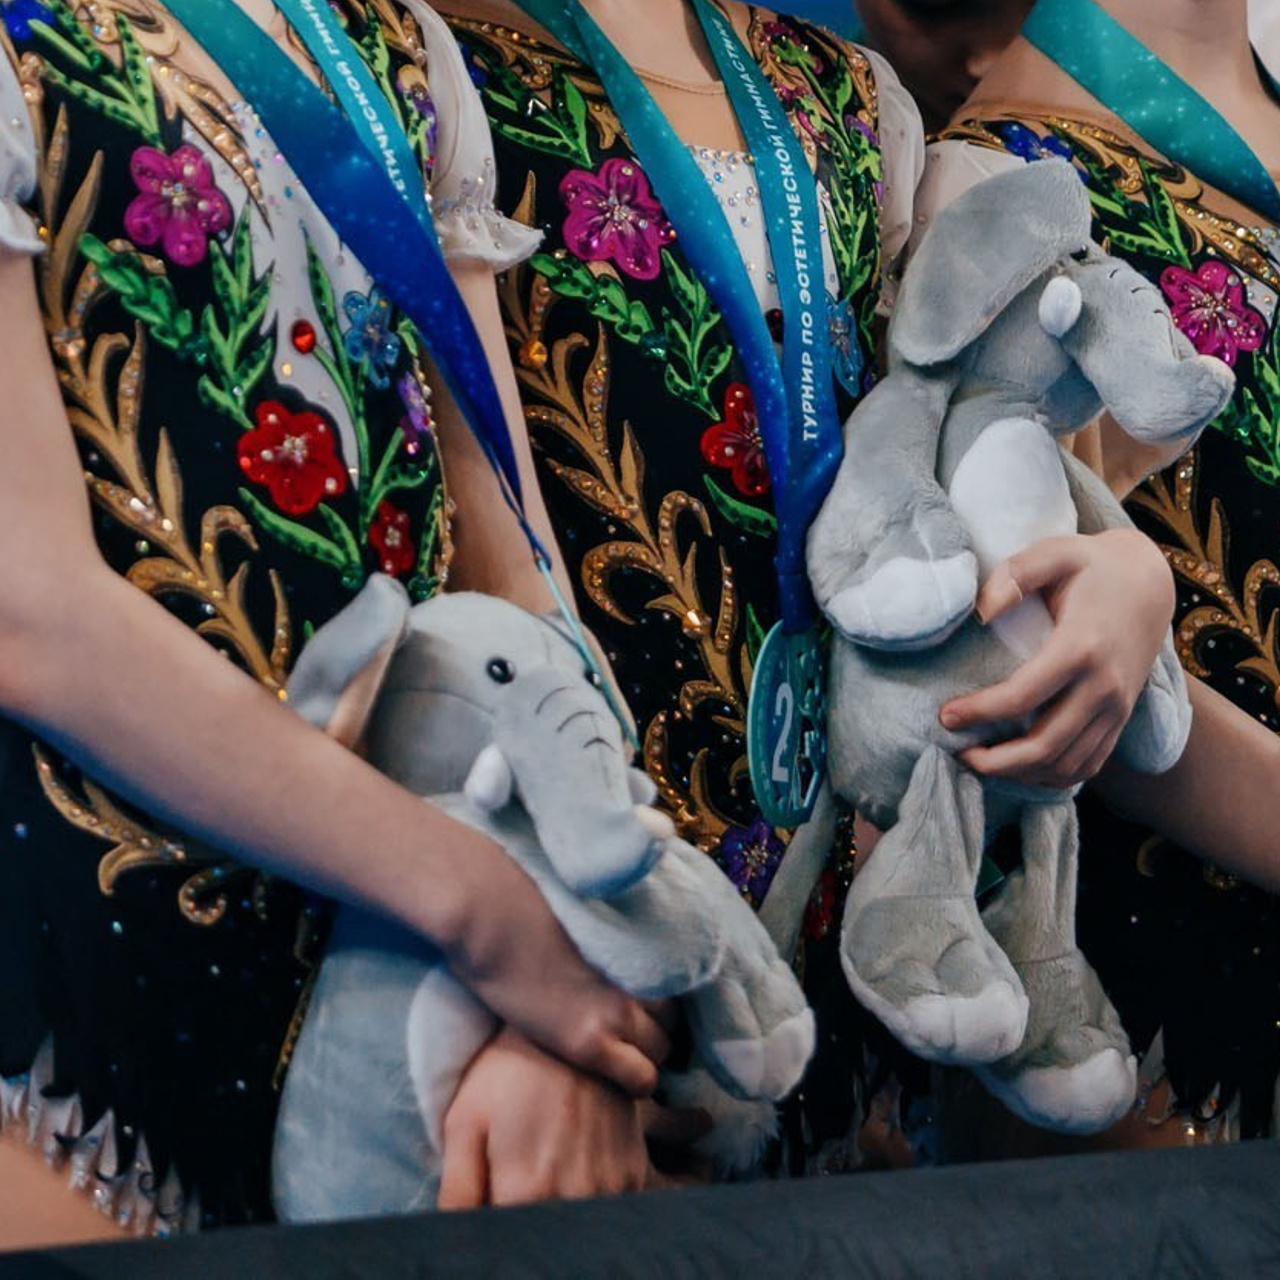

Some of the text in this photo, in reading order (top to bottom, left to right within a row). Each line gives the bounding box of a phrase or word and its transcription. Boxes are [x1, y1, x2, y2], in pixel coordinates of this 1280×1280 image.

[768, 134, 813, 306] ЭСТЕТИЧЕСКОЙ
[801, 311, 814, 346] ПО
[801, 351, 819, 442] ТУРНИР
[771, 681, 794, 783] 2
